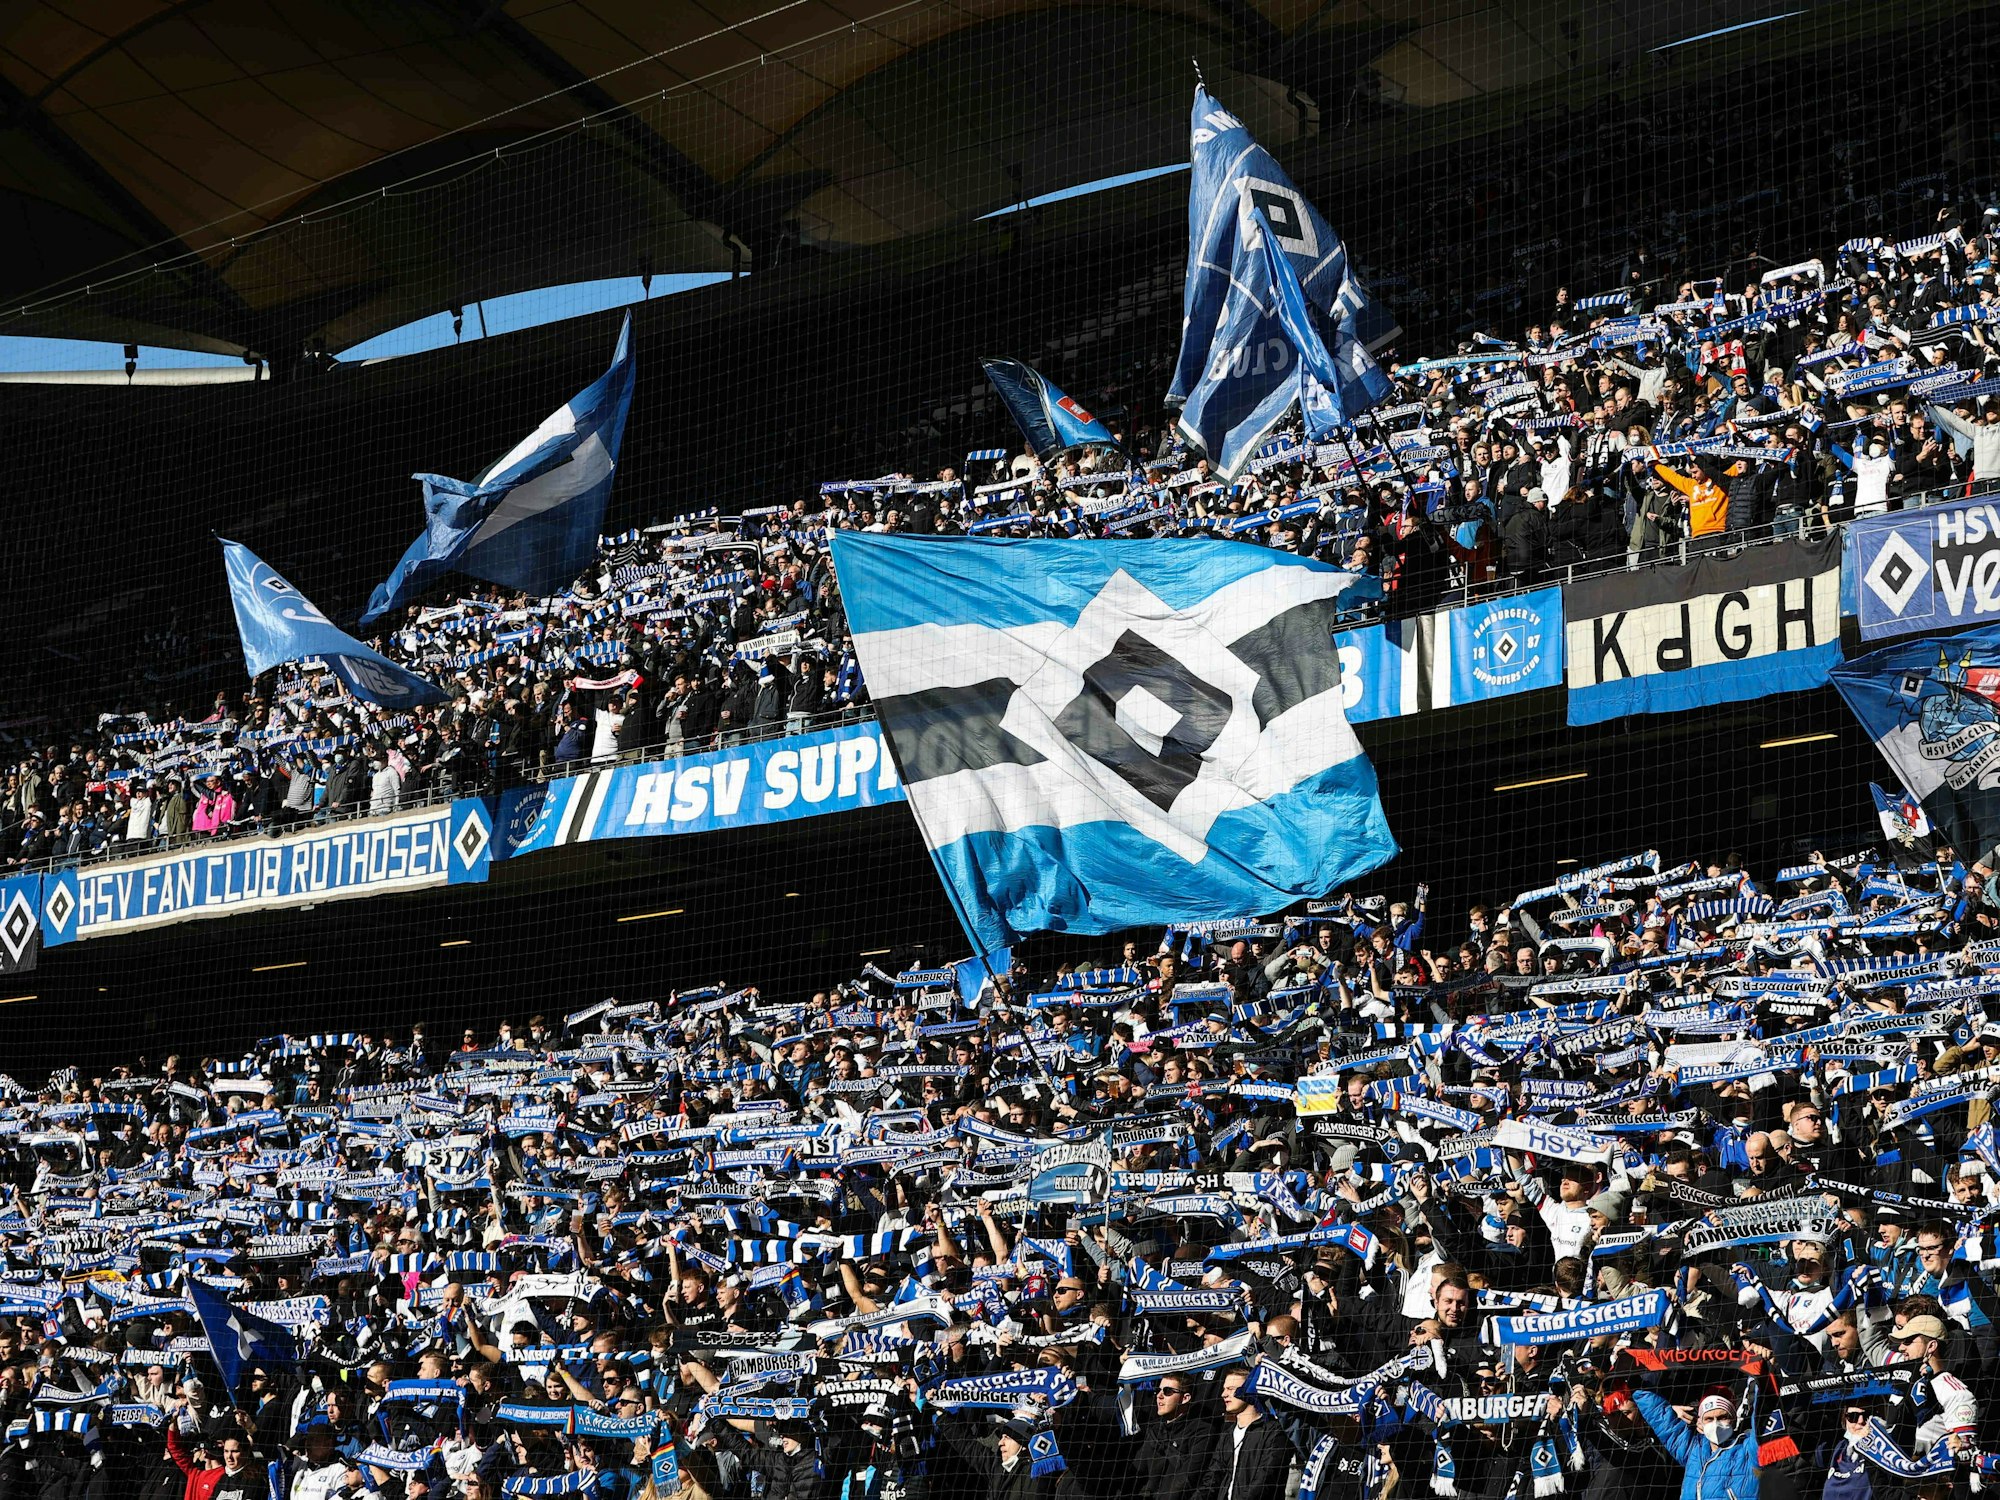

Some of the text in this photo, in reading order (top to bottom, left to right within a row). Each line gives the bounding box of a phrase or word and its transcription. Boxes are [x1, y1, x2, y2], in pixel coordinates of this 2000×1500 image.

[1528, 351, 1574, 365] HAMBURGER
[1801, 344, 1844, 364] HAMBURGER
[1831, 363, 1896, 386] HAMBURGER
[1375, 403, 1418, 422] AMBURGER
[1171, 470, 1193, 486] HSV
[1473, 609, 1527, 639] HAMBURGER
[1527, 635, 1540, 648] 87
[1473, 647, 1485, 660] 18
[1473, 654, 1539, 686] SUPPORTERS CLUB
[1926, 741, 1945, 756] HSV
[1950, 771, 1966, 789] THE
[625, 758, 750, 827] HSV
[78, 873, 135, 926] HSV
[142, 864, 196, 916] FAN
[204, 847, 280, 905] CLUB
[289, 819, 450, 894] ROTHOSEN
[900, 971, 950, 984] HAMBURG
[1769, 1002, 1816, 1016] STADION
[1848, 1016, 1925, 1037] AMBURGER
[1682, 1054, 1796, 1079] HAMBURGER S.V.
[1400, 1092, 1465, 1121] HAMBURGER
[632, 1116, 683, 1137] HSV
[1317, 1122, 1372, 1138] HAMBURGER
[423, 1133, 451, 1150] HSV
[1529, 1128, 1583, 1156] HSV
[715, 1151, 768, 1162] HAMBURGER
[681, 1183, 746, 1195] HAMBURGER
[1055, 1175, 1093, 1191] HAMBURG
[140, 1223, 204, 1240] HAMBURGER
[1685, 1219, 1801, 1254] HAMBURGER
[1221, 1241, 1243, 1253] MEIN
[1243, 1235, 1284, 1250] HAMBURG
[1310, 1230, 1325, 1241] ICH
[0, 1285, 44, 1298] BURGER
[1511, 1293, 1657, 1336] DERBYSIEGER
[1530, 1335, 1544, 1344] DIE
[1545, 1330, 1585, 1342] NUMMER
[1593, 1323, 1611, 1335] DER
[1614, 1319, 1641, 1332] STADT
[173, 1336, 209, 1351] MBURGE
[733, 1354, 800, 1375] HAMBURGER
[1259, 1365, 1352, 1407] HAMBURGER
[830, 1392, 887, 1407] STADION
